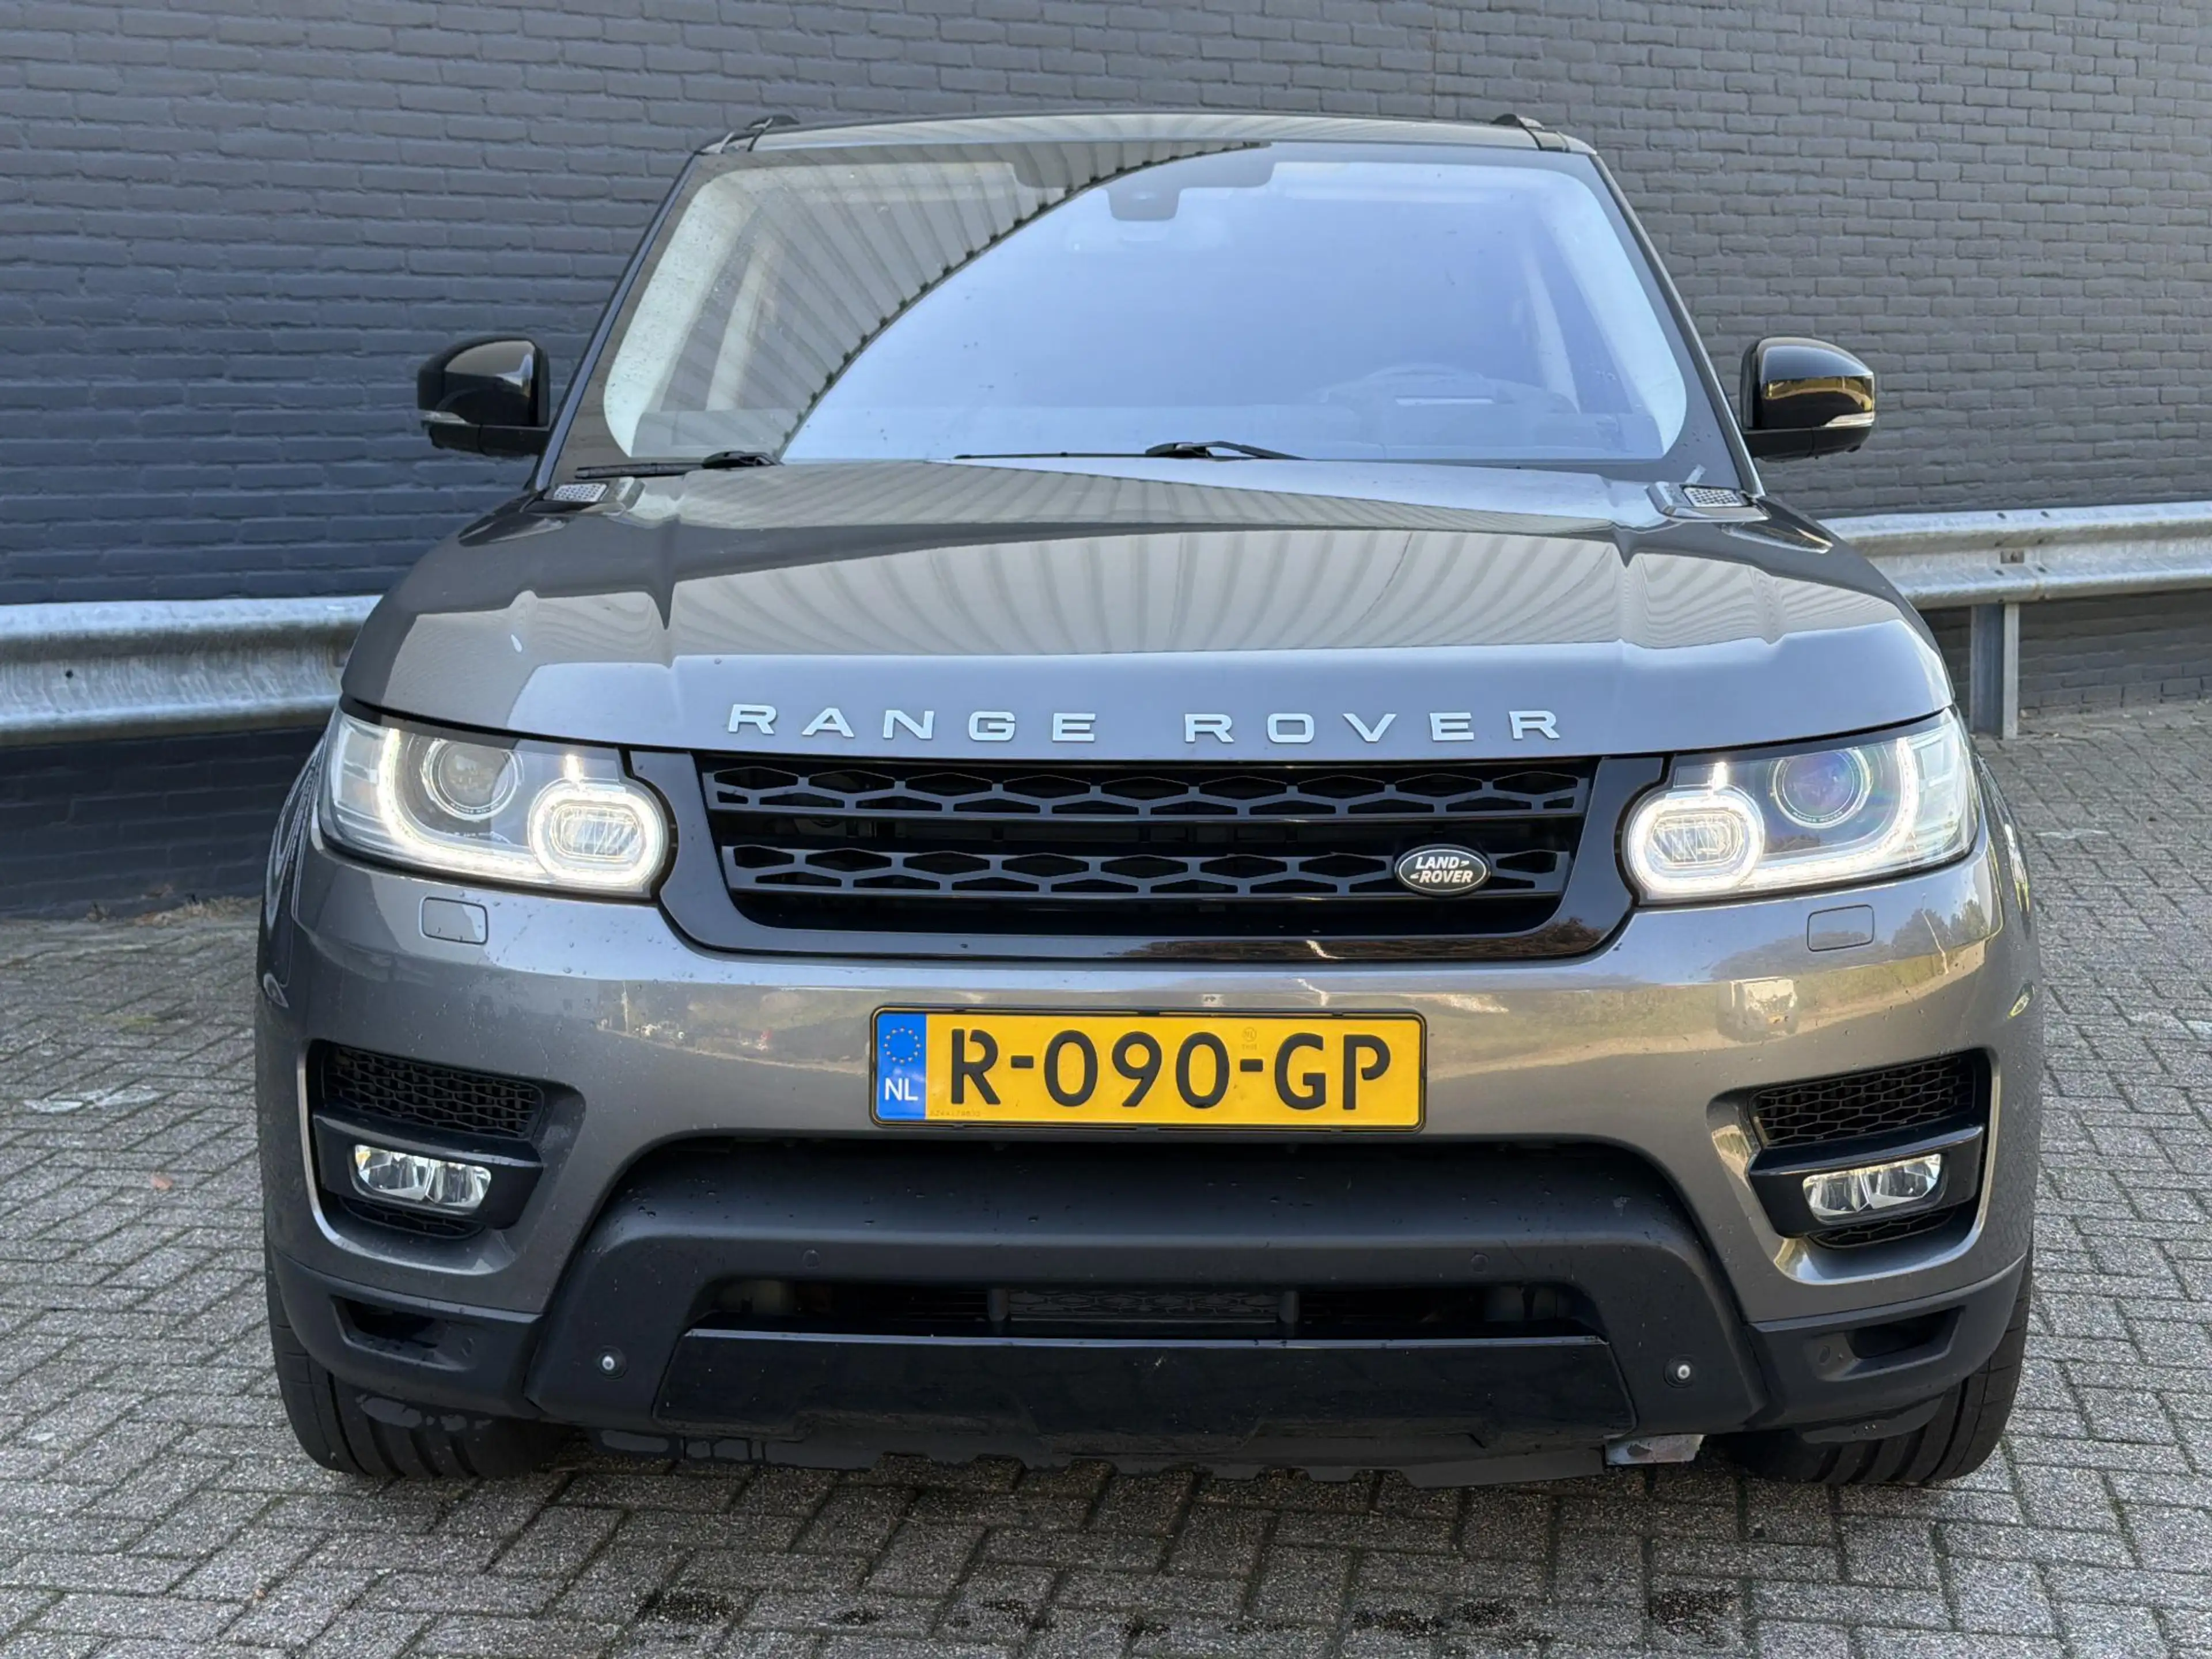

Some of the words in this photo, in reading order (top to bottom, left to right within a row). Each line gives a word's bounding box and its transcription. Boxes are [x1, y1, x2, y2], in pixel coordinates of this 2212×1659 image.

[728, 703, 1096, 743] RANGE
[1184, 710, 1561, 744] ROVER
[1415, 856, 1460, 870] LAND
[1419, 870, 1474, 884] ROVER
[950, 1028, 1391, 1110] R-090-GP
[884, 1077, 919, 1101] NL
